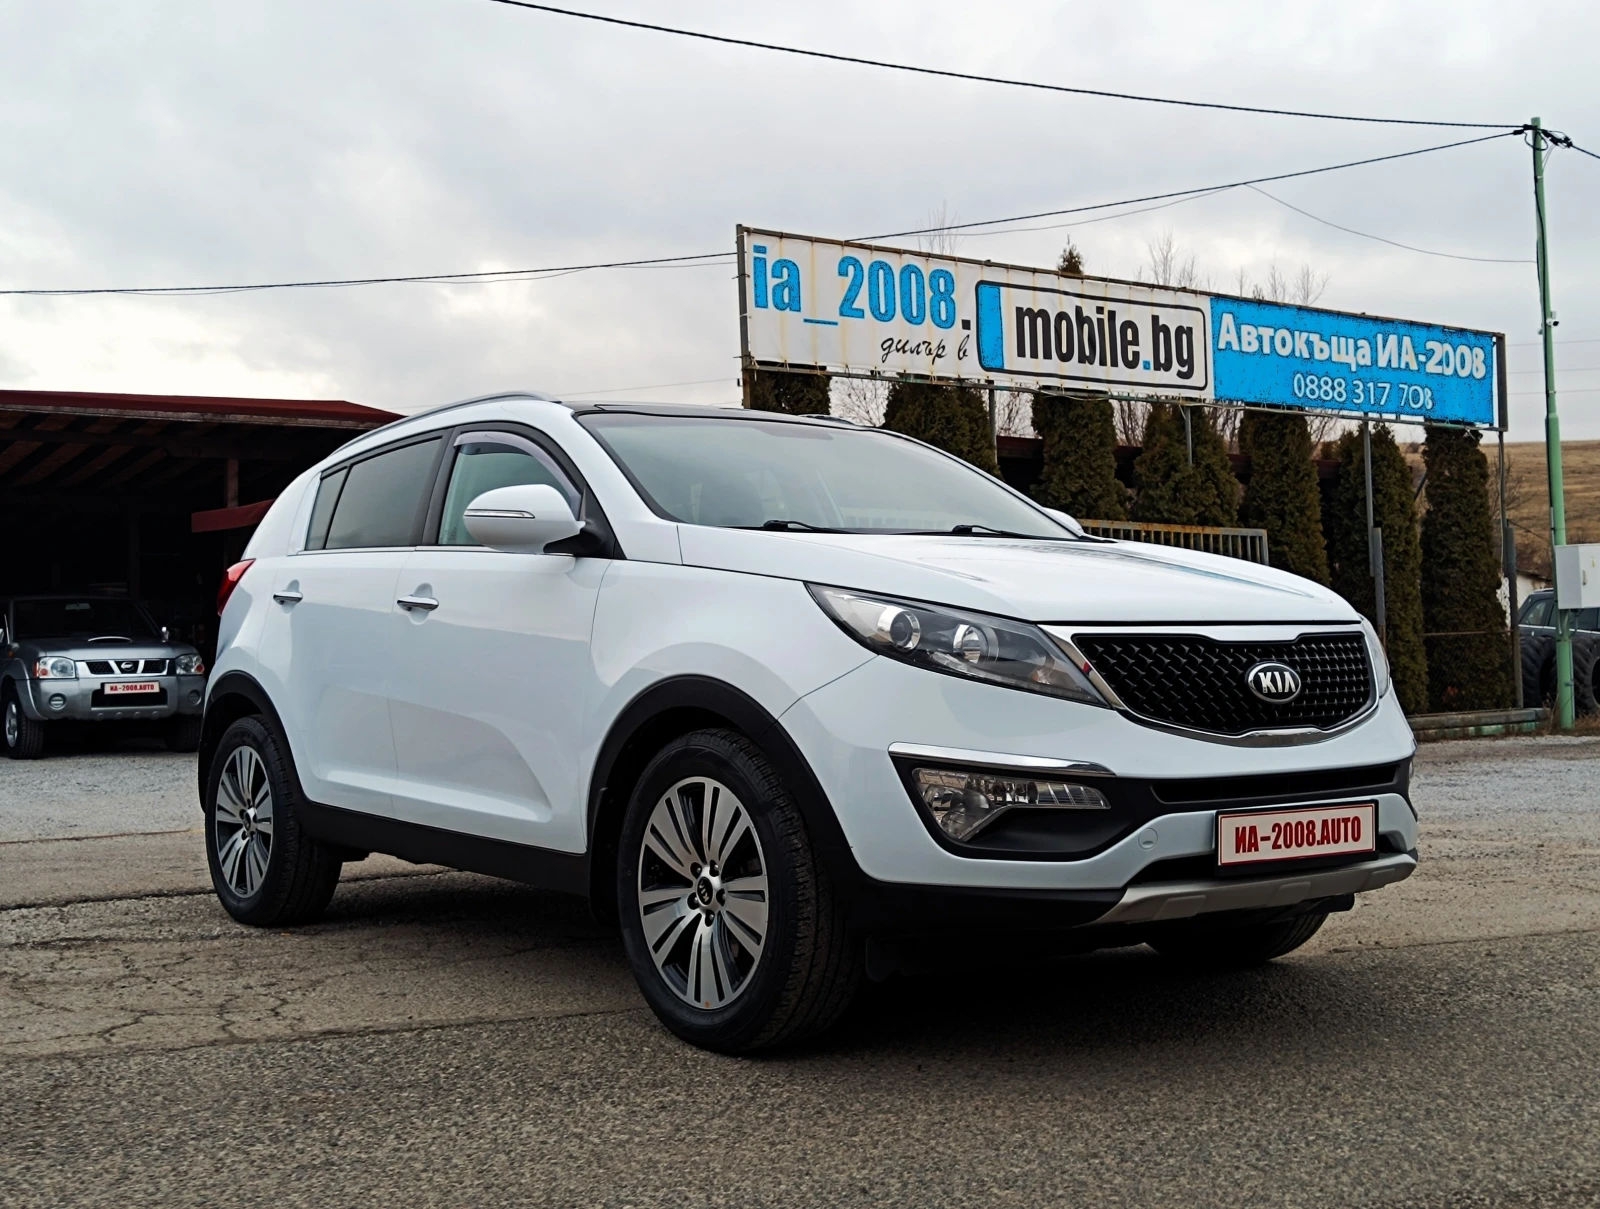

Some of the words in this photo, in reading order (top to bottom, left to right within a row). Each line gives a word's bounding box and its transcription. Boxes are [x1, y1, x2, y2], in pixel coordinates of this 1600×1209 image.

[881, 337, 948, 365] дилър
[1015, 305, 1195, 380] mobile.bg
[1218, 313, 1372, 372] Автокъща
[1377, 333, 1486, 380] ИА-2008
[1293, 373, 1347, 401] 0888
[1353, 380, 1390, 406] 317
[1399, 383, 1433, 410] 708
[1258, 671, 1296, 693] KIA
[1234, 815, 1362, 854] ИА-2008.AUTO
